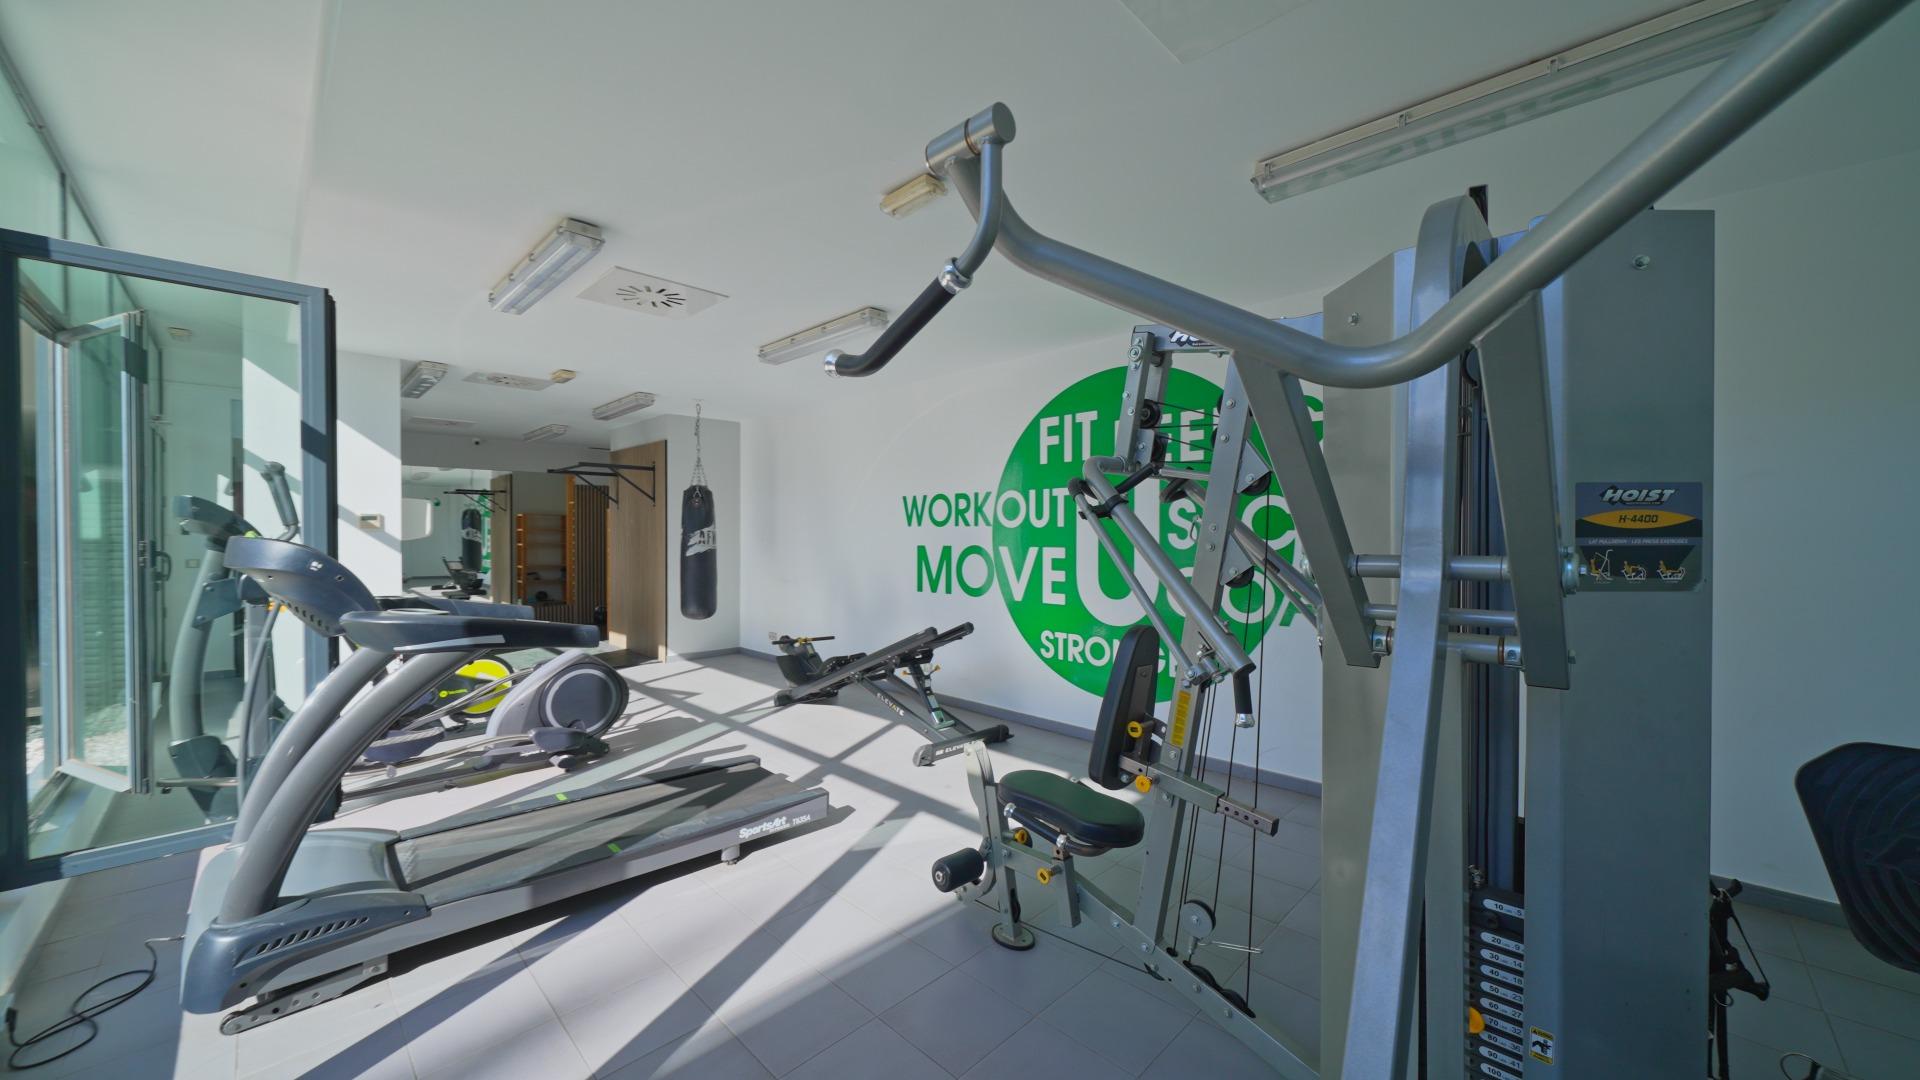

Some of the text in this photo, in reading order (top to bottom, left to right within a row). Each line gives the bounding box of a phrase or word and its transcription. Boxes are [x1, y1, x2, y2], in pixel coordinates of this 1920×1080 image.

[1039, 410, 1098, 465] FIT
[1603, 489, 1675, 501] HOIST
[903, 488, 1070, 528] WORKOUT
[1618, 515, 1658, 523] H-4400
[916, 545, 1067, 606] MOVE
[739, 816, 787, 839] SportsArt
[1491, 936, 1502, 945] 20
[1489, 952, 1500, 961] 30
[1489, 969, 1500, 977] 40
[1489, 985, 1500, 994] 50
[1488, 1002, 1499, 1010] 60
[1488, 1018, 1499, 1026] 70
[1487, 1050, 1498, 1059] 90
[1487, 1066, 1502, 1077] 100
